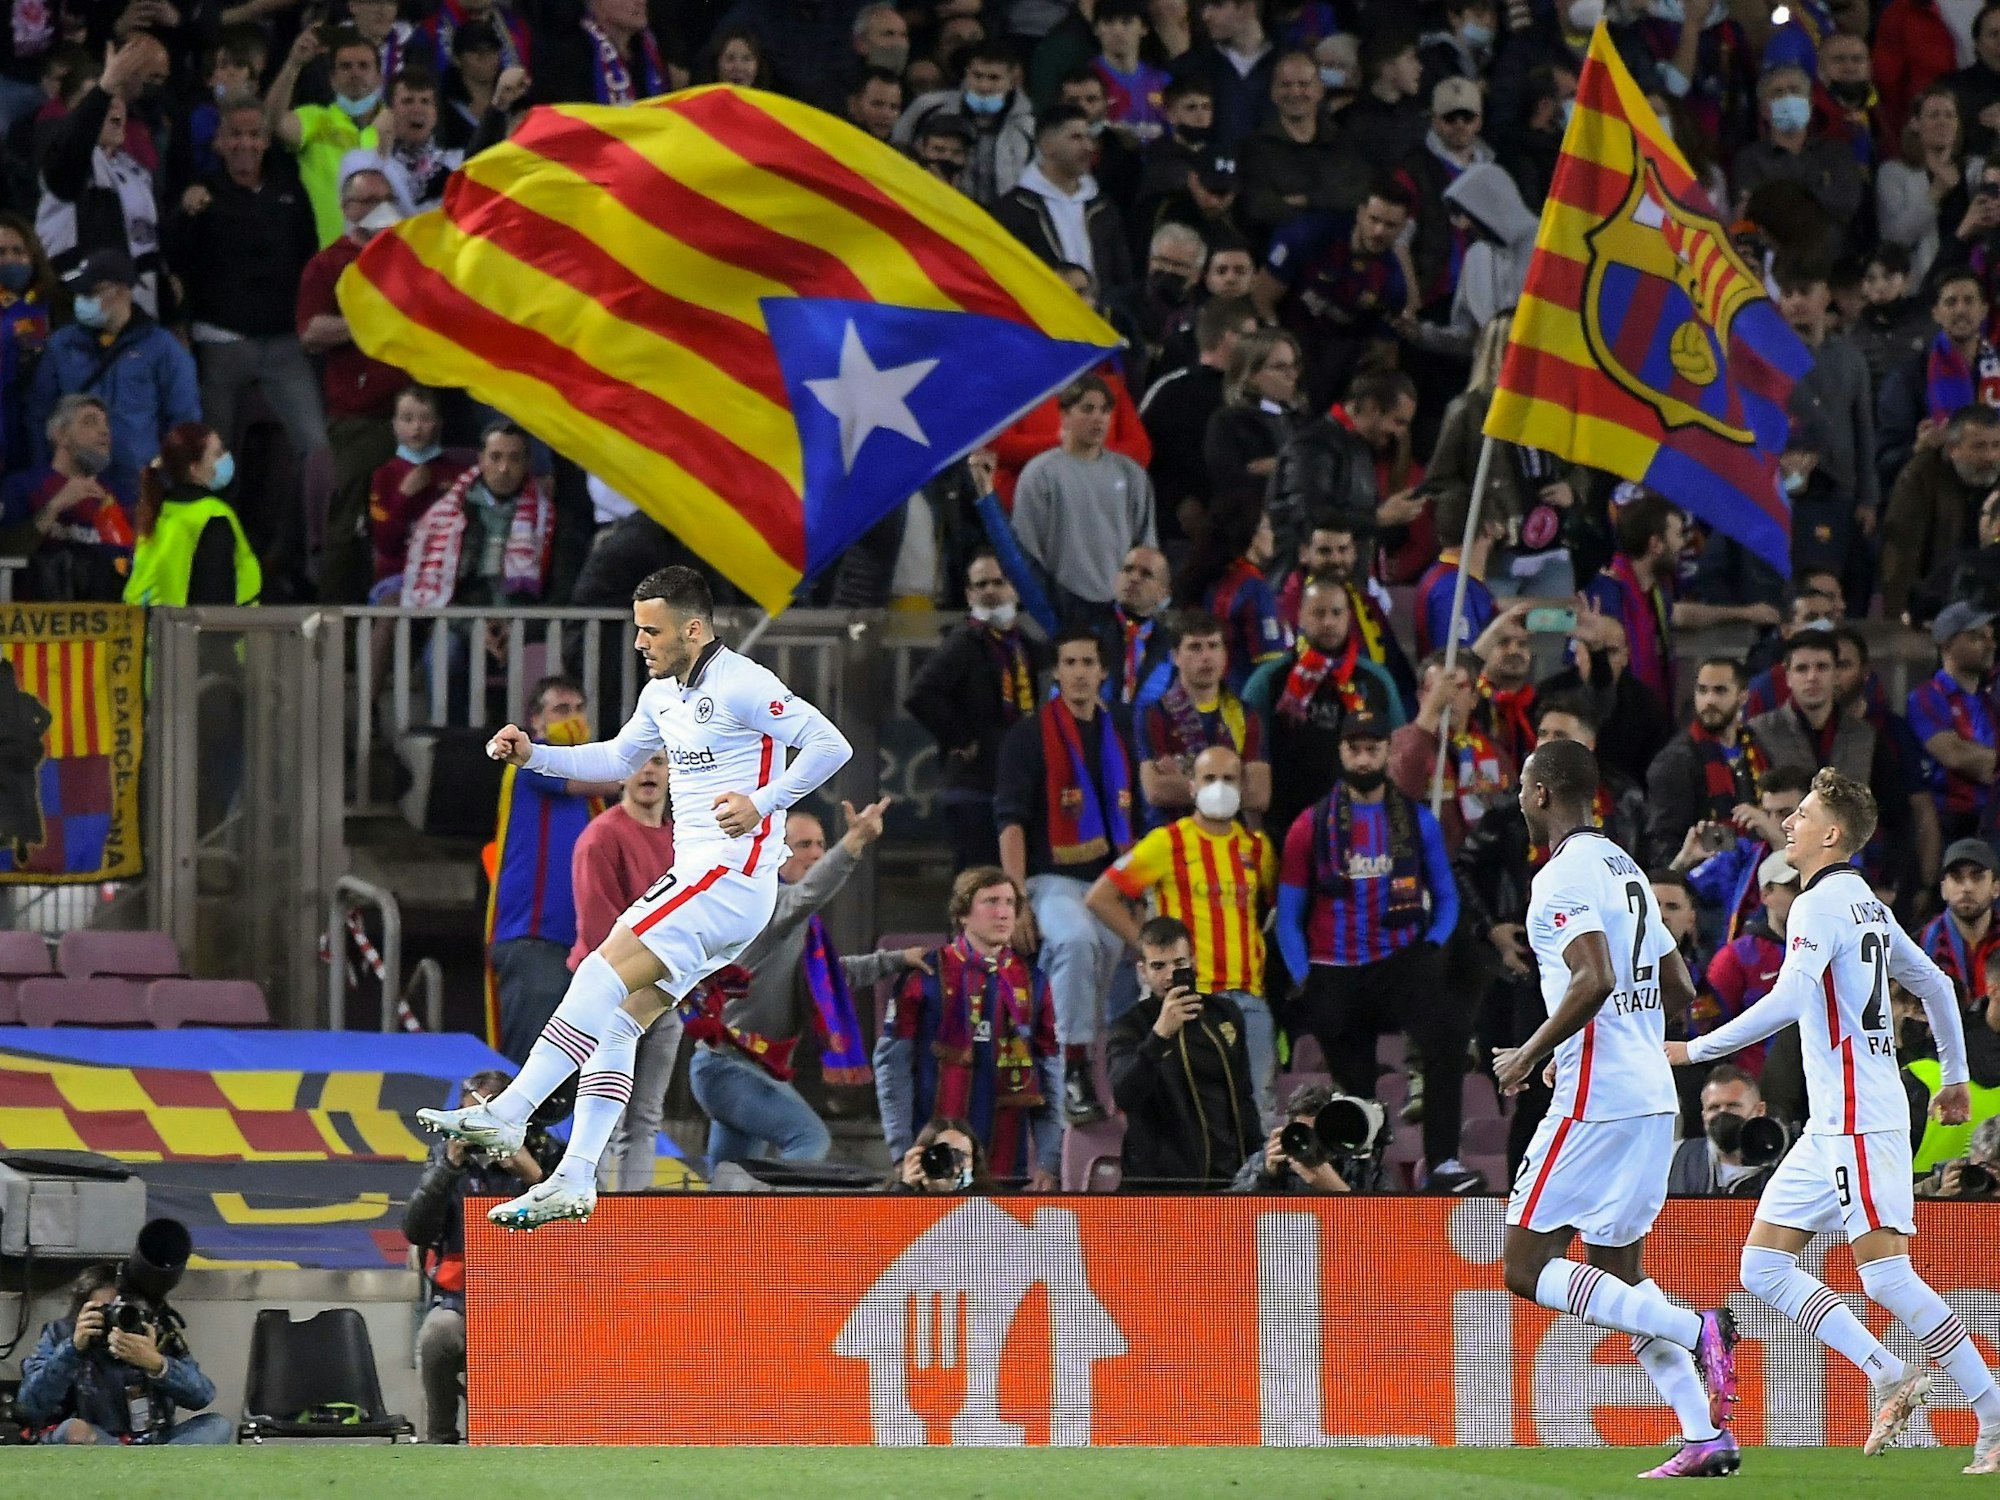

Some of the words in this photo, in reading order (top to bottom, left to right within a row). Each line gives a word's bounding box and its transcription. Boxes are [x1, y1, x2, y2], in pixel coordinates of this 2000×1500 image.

[0, 608, 108, 636] AVERS
[1625, 880, 1653, 983] 2
[1835, 1165, 1851, 1207] 9
